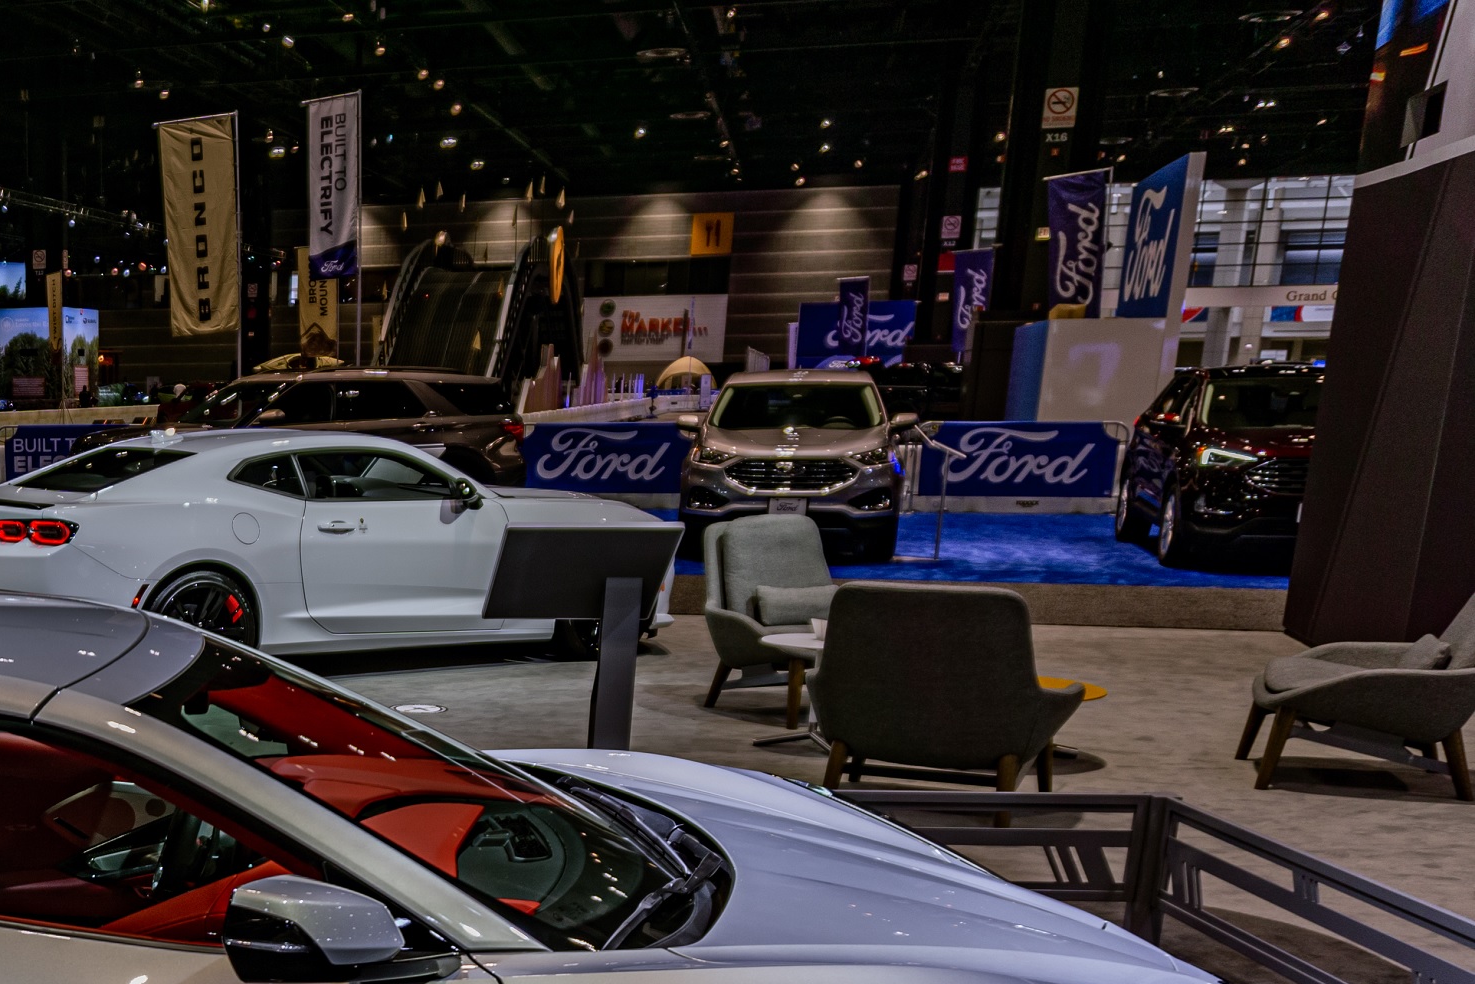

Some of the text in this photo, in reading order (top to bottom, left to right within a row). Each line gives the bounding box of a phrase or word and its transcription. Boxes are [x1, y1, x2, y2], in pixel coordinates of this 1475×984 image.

[334, 113, 347, 191] BUILT TO
[1046, 131, 1068, 143] X16
[320, 115, 333, 236] ELECTRIFY
[190, 137, 212, 322] BRONCO
[1056, 202, 1100, 306] Ford
[1124, 185, 1175, 302] Ford
[320, 260, 344, 272] Ford
[841, 292, 865, 343] Ford
[1286, 290, 1327, 302] Grand
[12, 437, 61, 453] BUILT
[537, 428, 672, 481] Ford
[941, 426, 1096, 484] Ford
[776, 501, 799, 512] Ford
